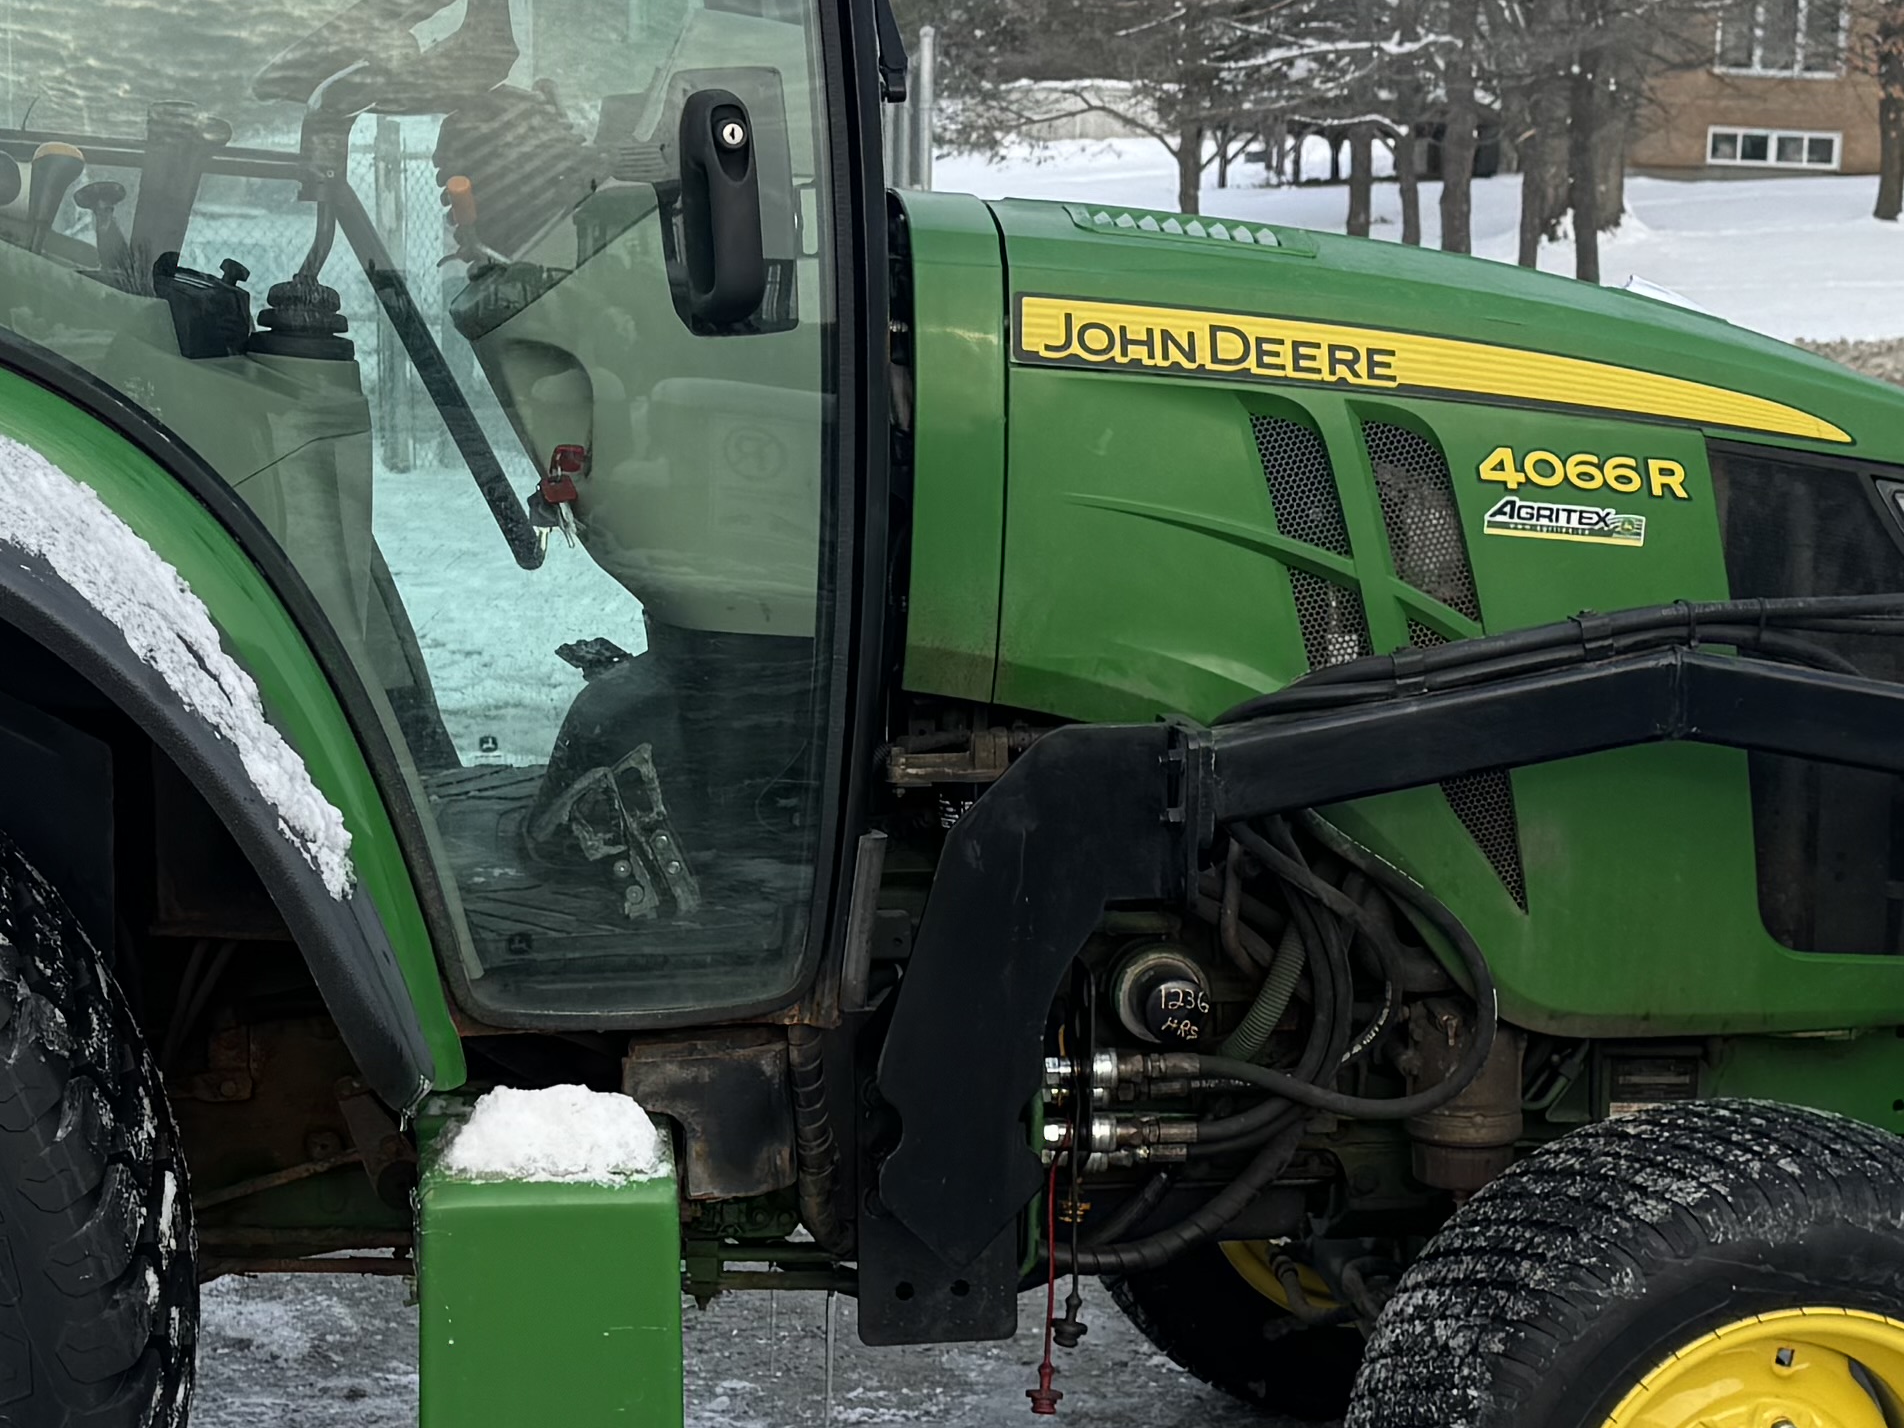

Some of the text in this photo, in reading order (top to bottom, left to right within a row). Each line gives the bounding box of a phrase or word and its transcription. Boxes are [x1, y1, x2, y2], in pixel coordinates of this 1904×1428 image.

[1043, 312, 1397, 382] JOHN DEERE
[1478, 446, 1689, 499] 4066R
[1489, 499, 1612, 528] AGRITEX
[1159, 985, 1210, 1014] 1236
